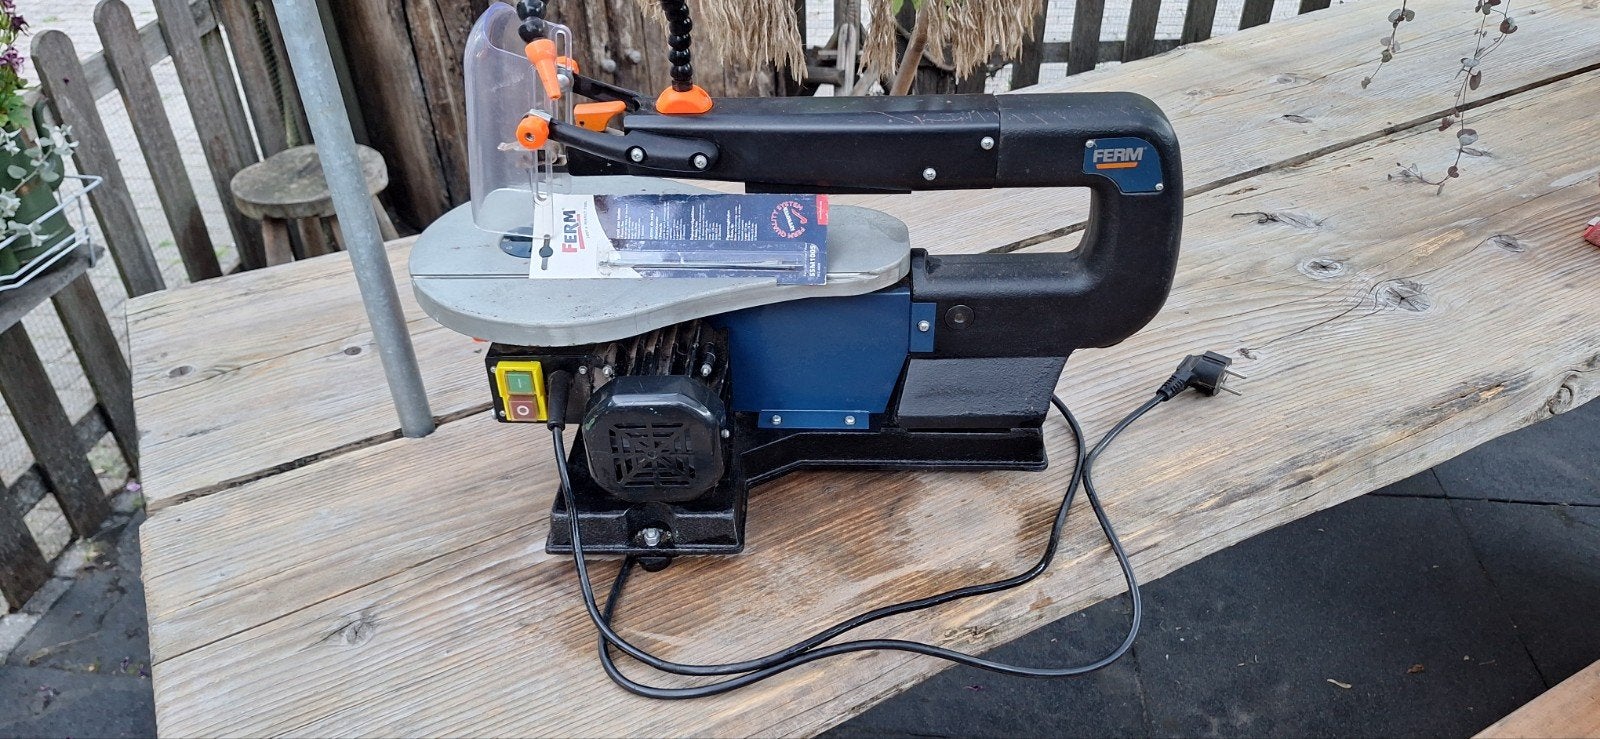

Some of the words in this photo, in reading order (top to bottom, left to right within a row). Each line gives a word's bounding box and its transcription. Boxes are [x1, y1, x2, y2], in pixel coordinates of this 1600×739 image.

[1093, 147, 1144, 163] FERM
[776, 201, 803, 210] SYSTEM
[561, 209, 578, 253] FERM
[771, 209, 787, 238] QUALITY
[788, 226, 806, 239] FERM
